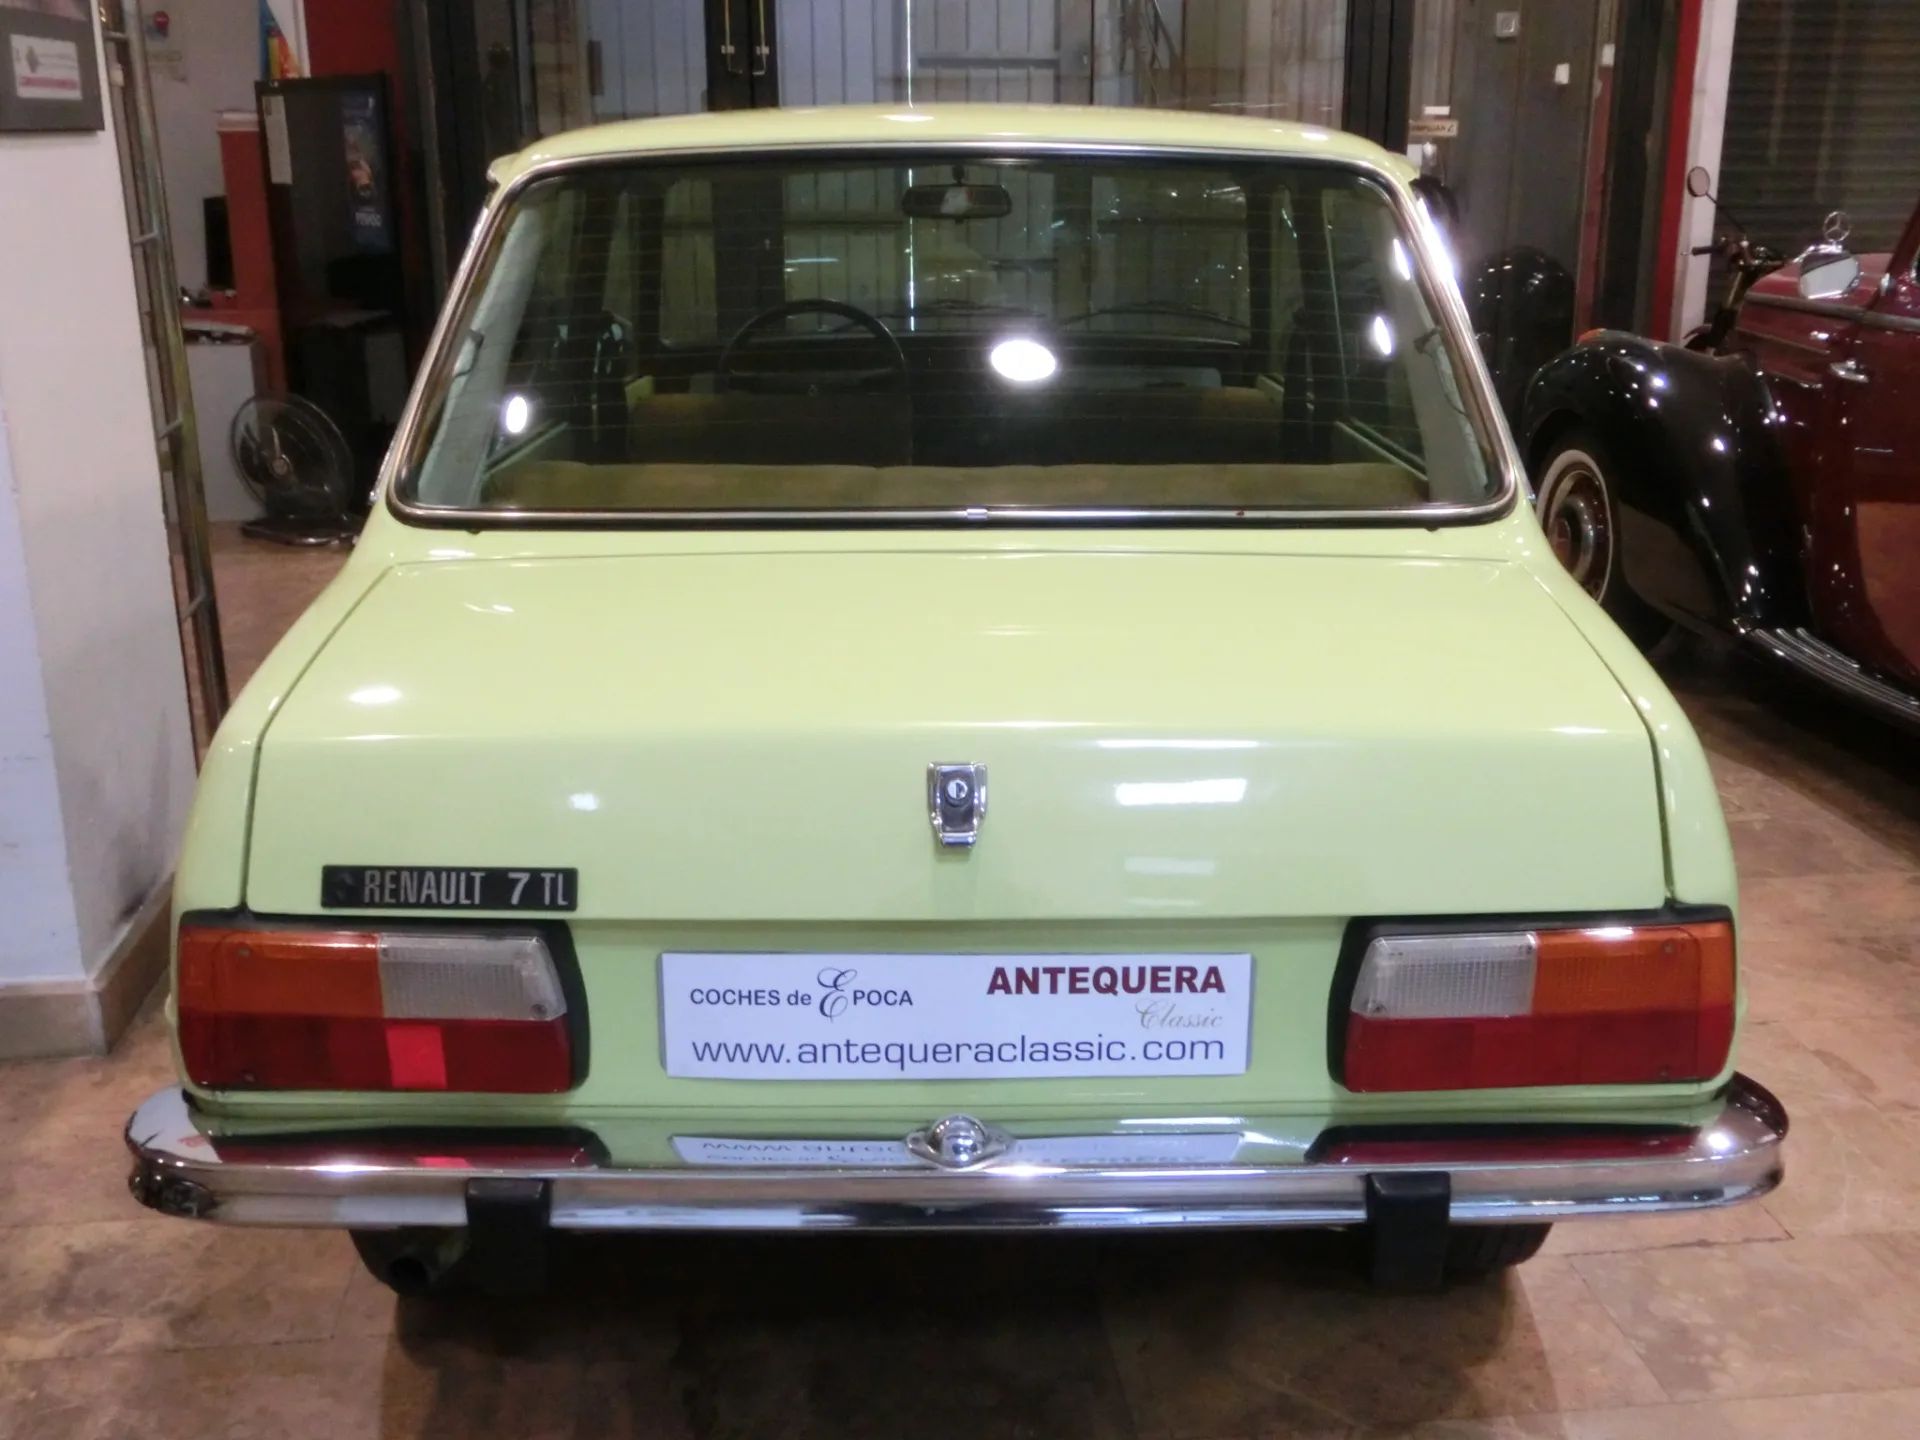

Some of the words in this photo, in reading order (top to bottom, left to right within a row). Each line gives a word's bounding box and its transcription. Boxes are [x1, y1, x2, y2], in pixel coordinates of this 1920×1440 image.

[363, 869, 485, 905] RENAULT
[508, 872, 530, 905] 7
[540, 873, 568, 905] TL
[986, 966, 1226, 996] ANTEQUERA
[690, 989, 781, 1006] COCHES
[787, 989, 812, 1006] de
[1135, 1000, 1223, 1029] Classic
[692, 1034, 1224, 1071] www.antequeraclassic.com
